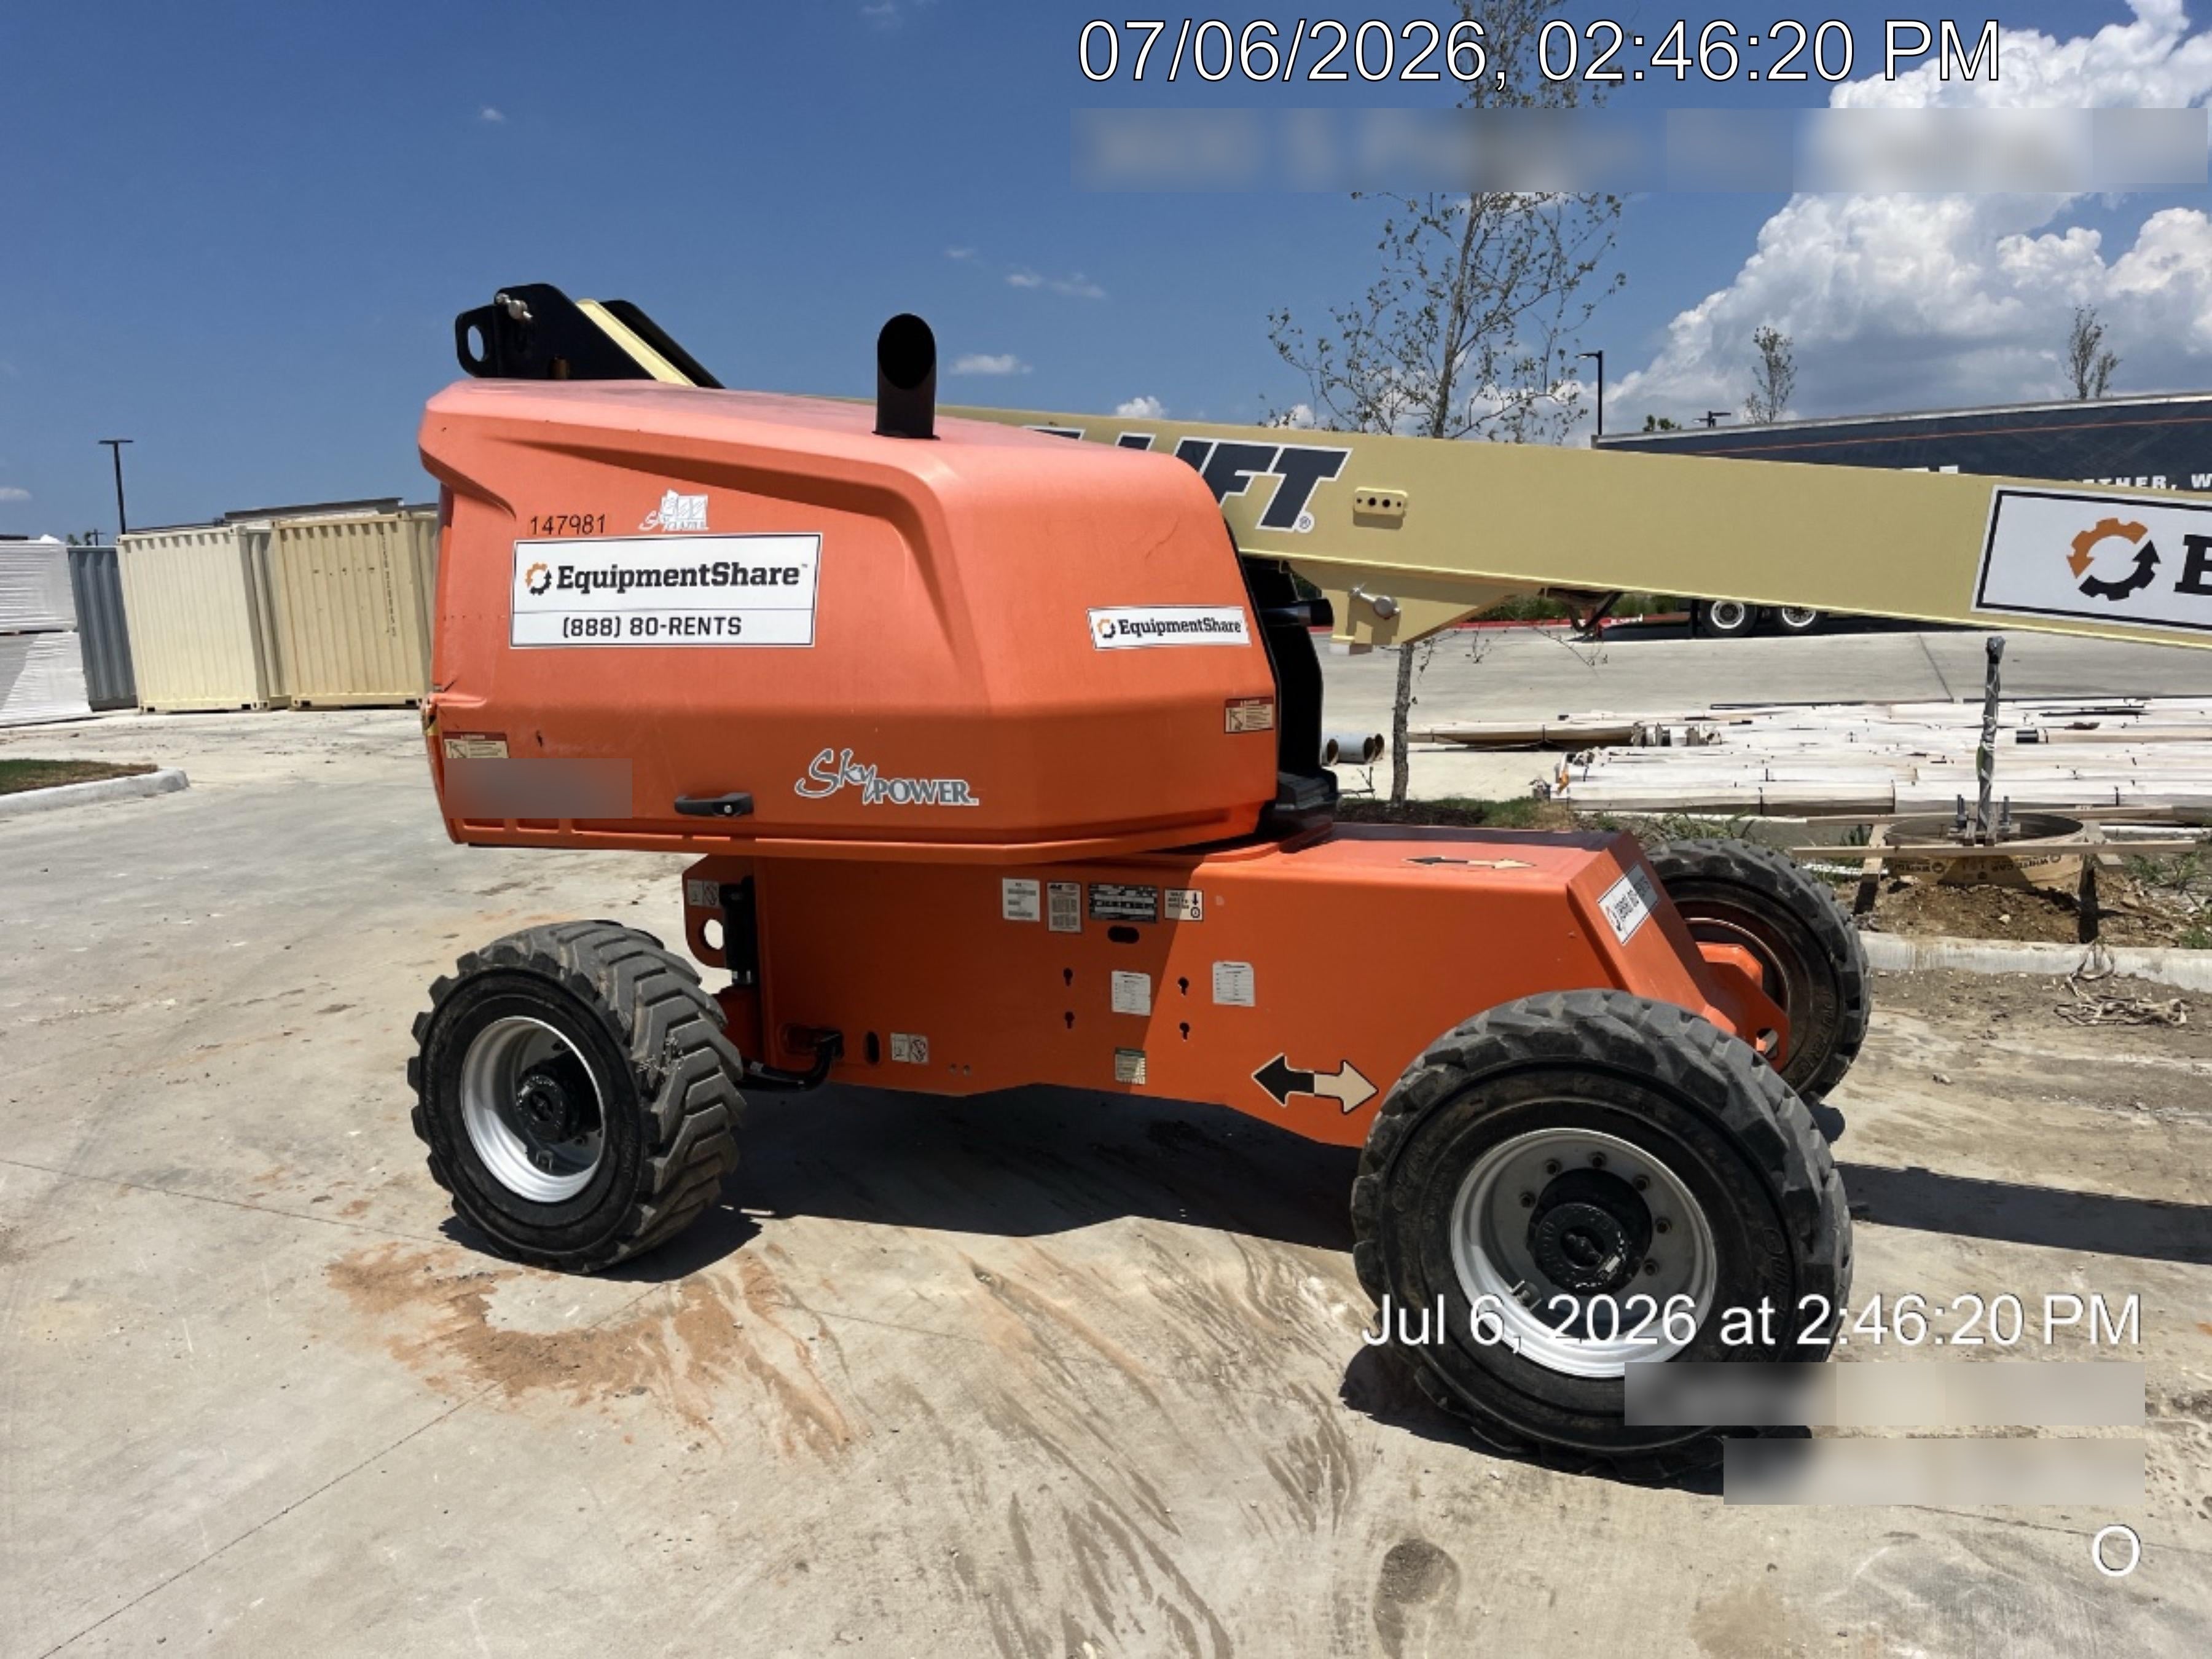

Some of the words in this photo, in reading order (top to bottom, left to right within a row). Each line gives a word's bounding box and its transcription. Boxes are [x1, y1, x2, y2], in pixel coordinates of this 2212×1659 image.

[530, 514, 606, 535] 147981
[557, 562, 799, 594] EquipmentShare
[563, 616, 621, 638] (888)
[630, 617, 742, 635] 80-RENTS
[1118, 616, 1242, 638] EquipmentShare
